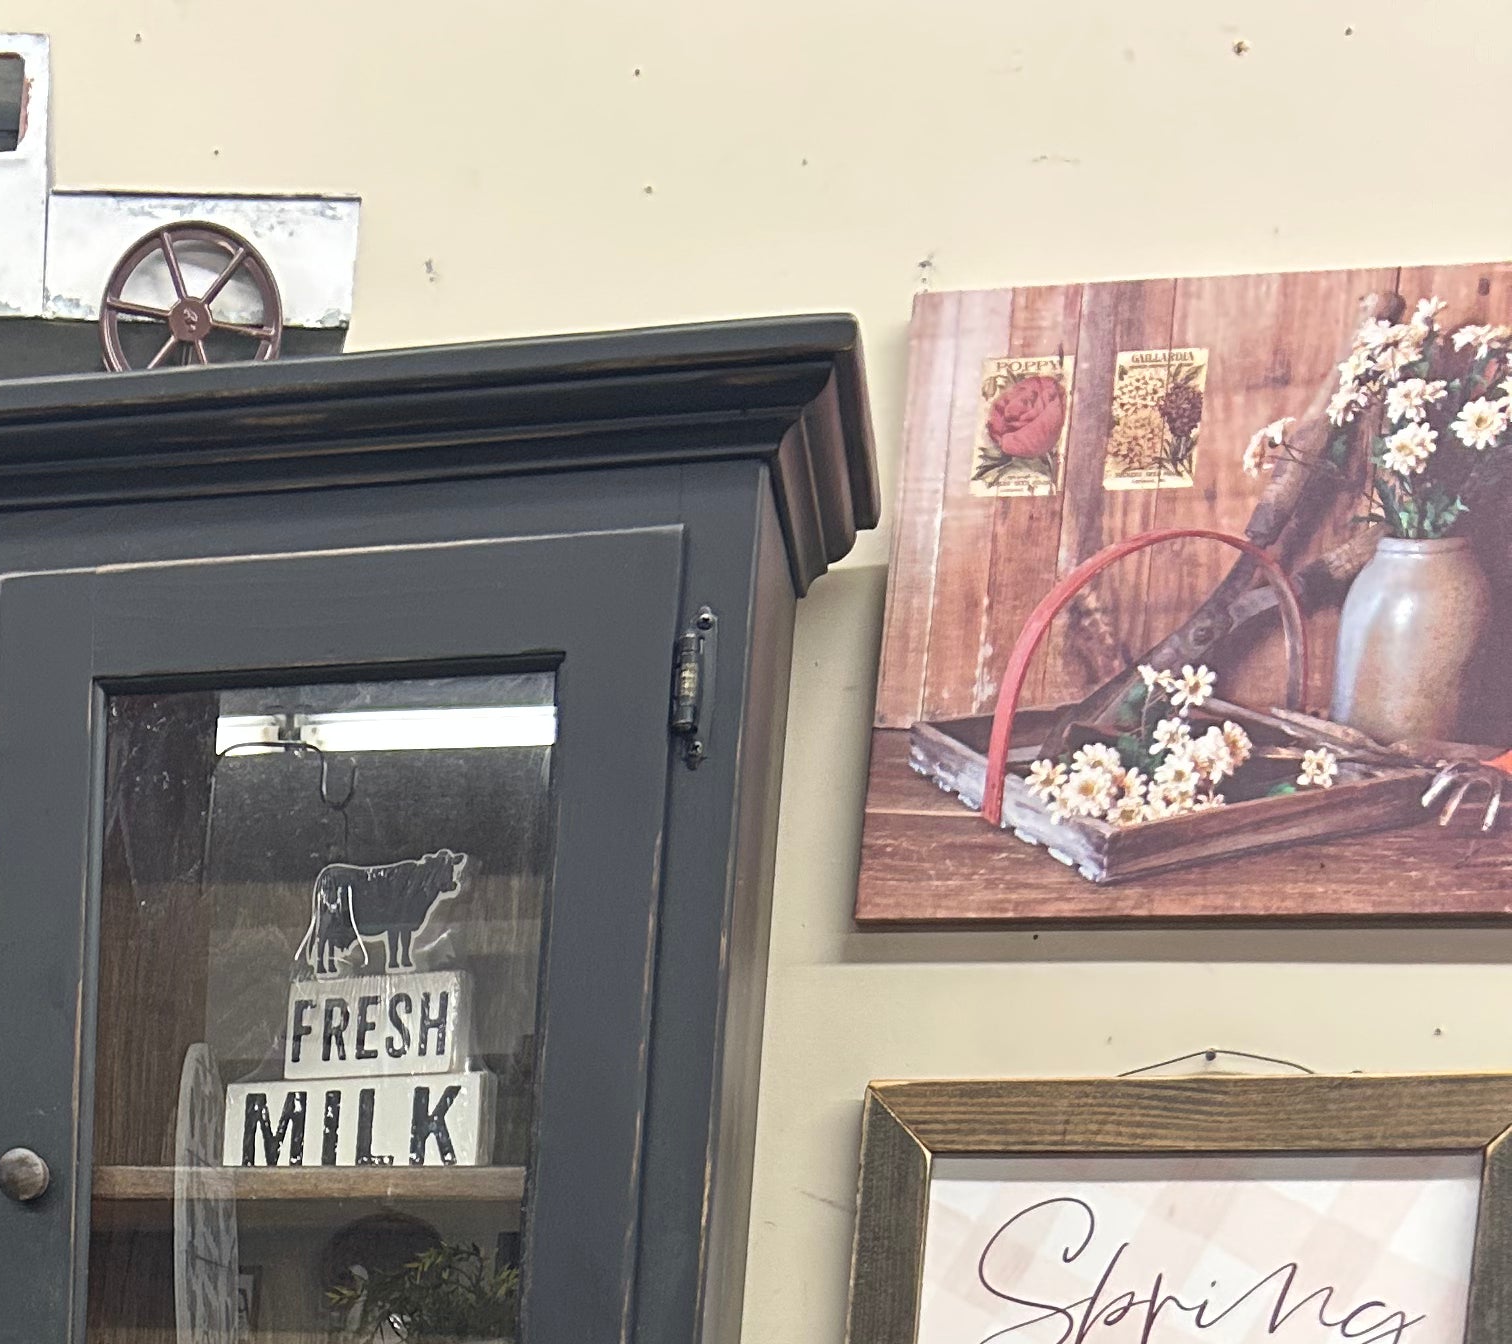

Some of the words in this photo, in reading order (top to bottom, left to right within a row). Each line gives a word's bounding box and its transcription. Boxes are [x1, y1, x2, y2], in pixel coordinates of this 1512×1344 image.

[996, 360, 1061, 373] POPPY
[1131, 352, 1194, 363] GAILLARDIA
[291, 991, 449, 1063] FRESH
[242, 1085, 462, 1166] MILK
